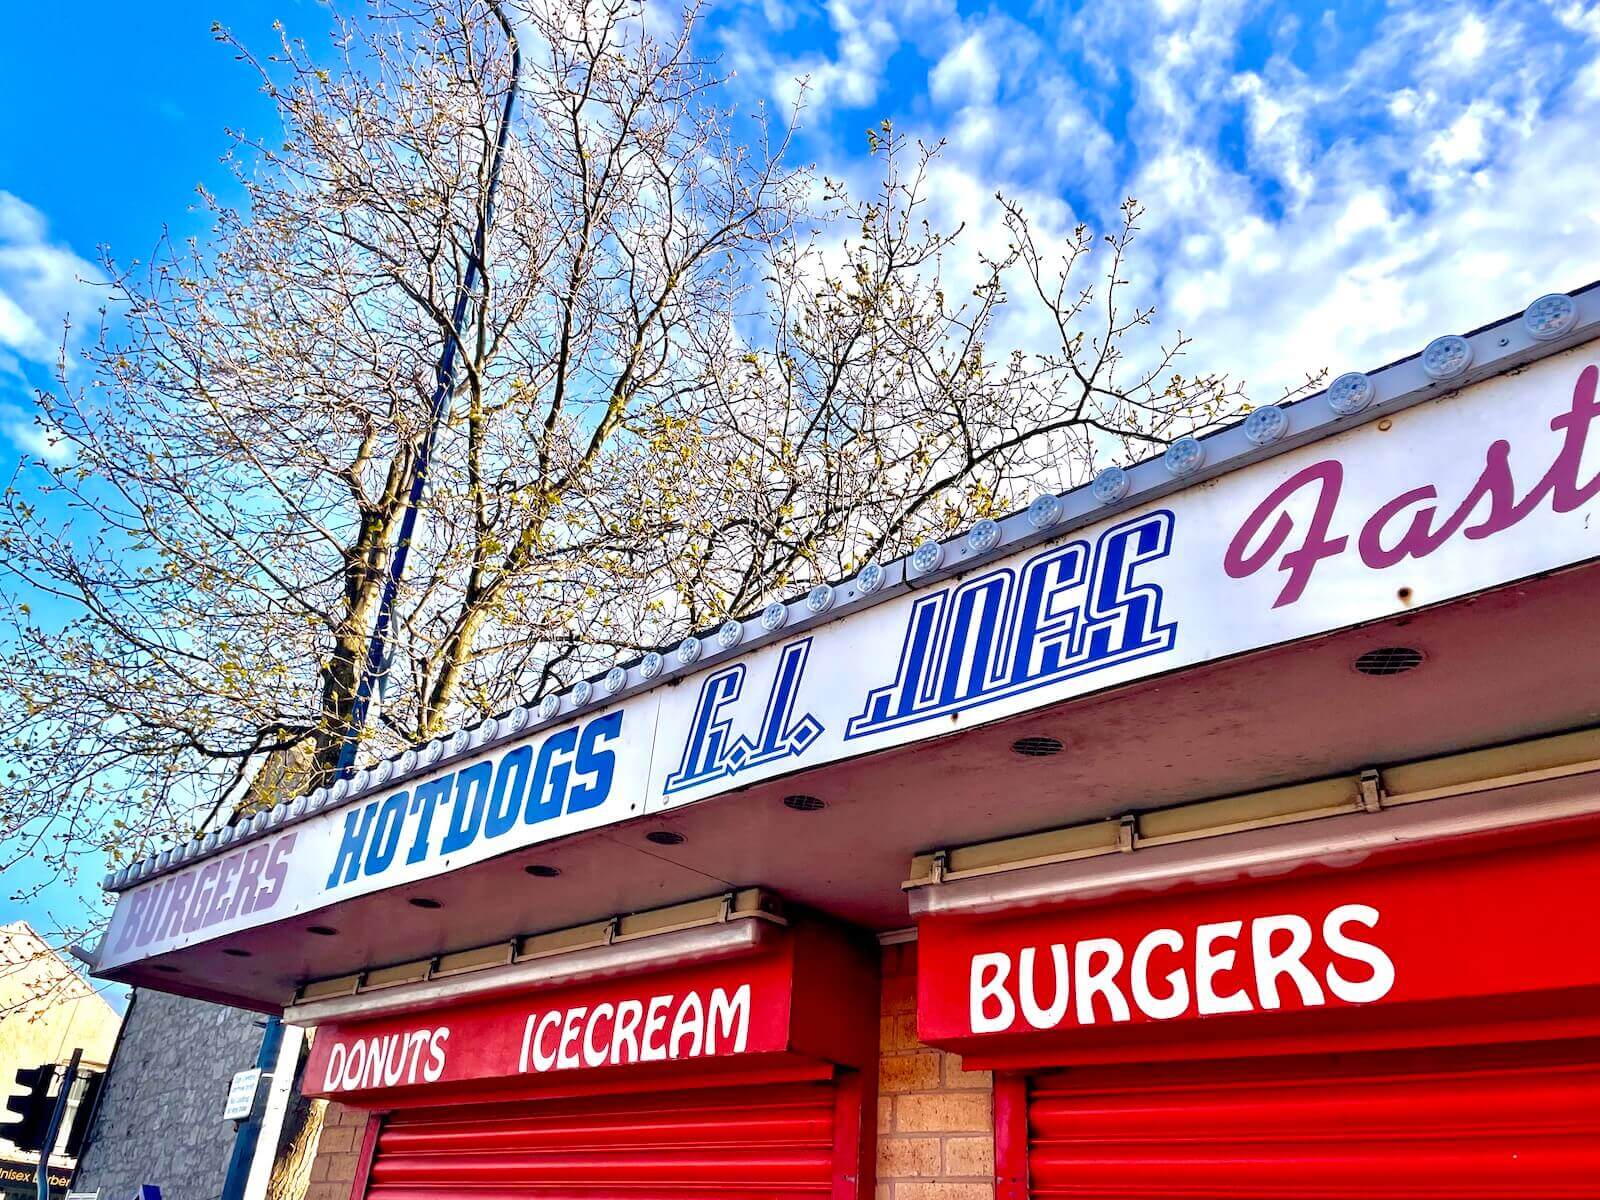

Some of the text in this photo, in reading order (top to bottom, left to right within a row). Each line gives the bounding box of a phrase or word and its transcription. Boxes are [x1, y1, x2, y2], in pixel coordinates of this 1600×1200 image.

[1223, 364, 1600, 609] Fast
[843, 508, 1178, 741] JOES
[325, 710, 624, 890] HOTDOGS
[114, 833, 297, 955] BURGERS
[969, 904, 1396, 1034] BURGERS
[322, 983, 752, 1093] DONUTS ICECREAM
[32, 1172, 71, 1187] Brber
